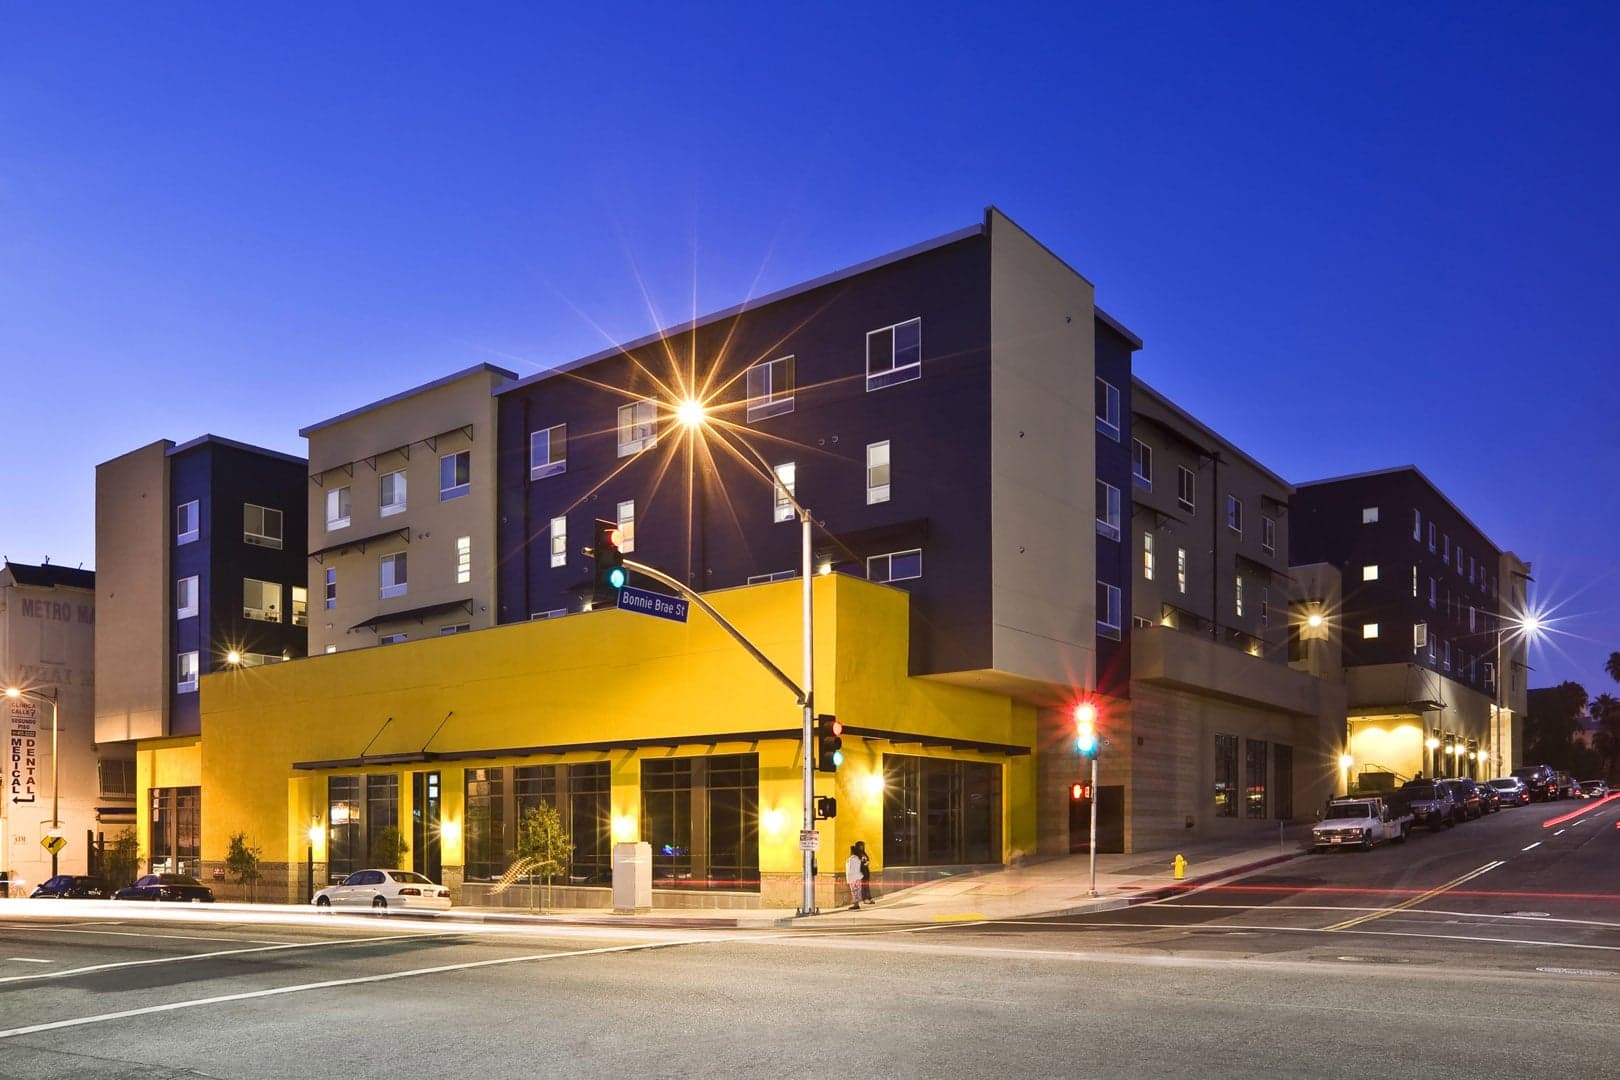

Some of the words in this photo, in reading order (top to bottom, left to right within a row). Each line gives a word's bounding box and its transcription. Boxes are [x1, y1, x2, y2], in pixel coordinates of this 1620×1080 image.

[21, 598, 71, 622] METRO
[622, 592, 653, 609] Bonnie
[655, 599, 674, 614] Brae
[675, 603, 685, 617] St
[30, 709, 36, 717] 7
[11, 738, 22, 794] MEDICAL
[26, 739, 36, 794] DENTAL
